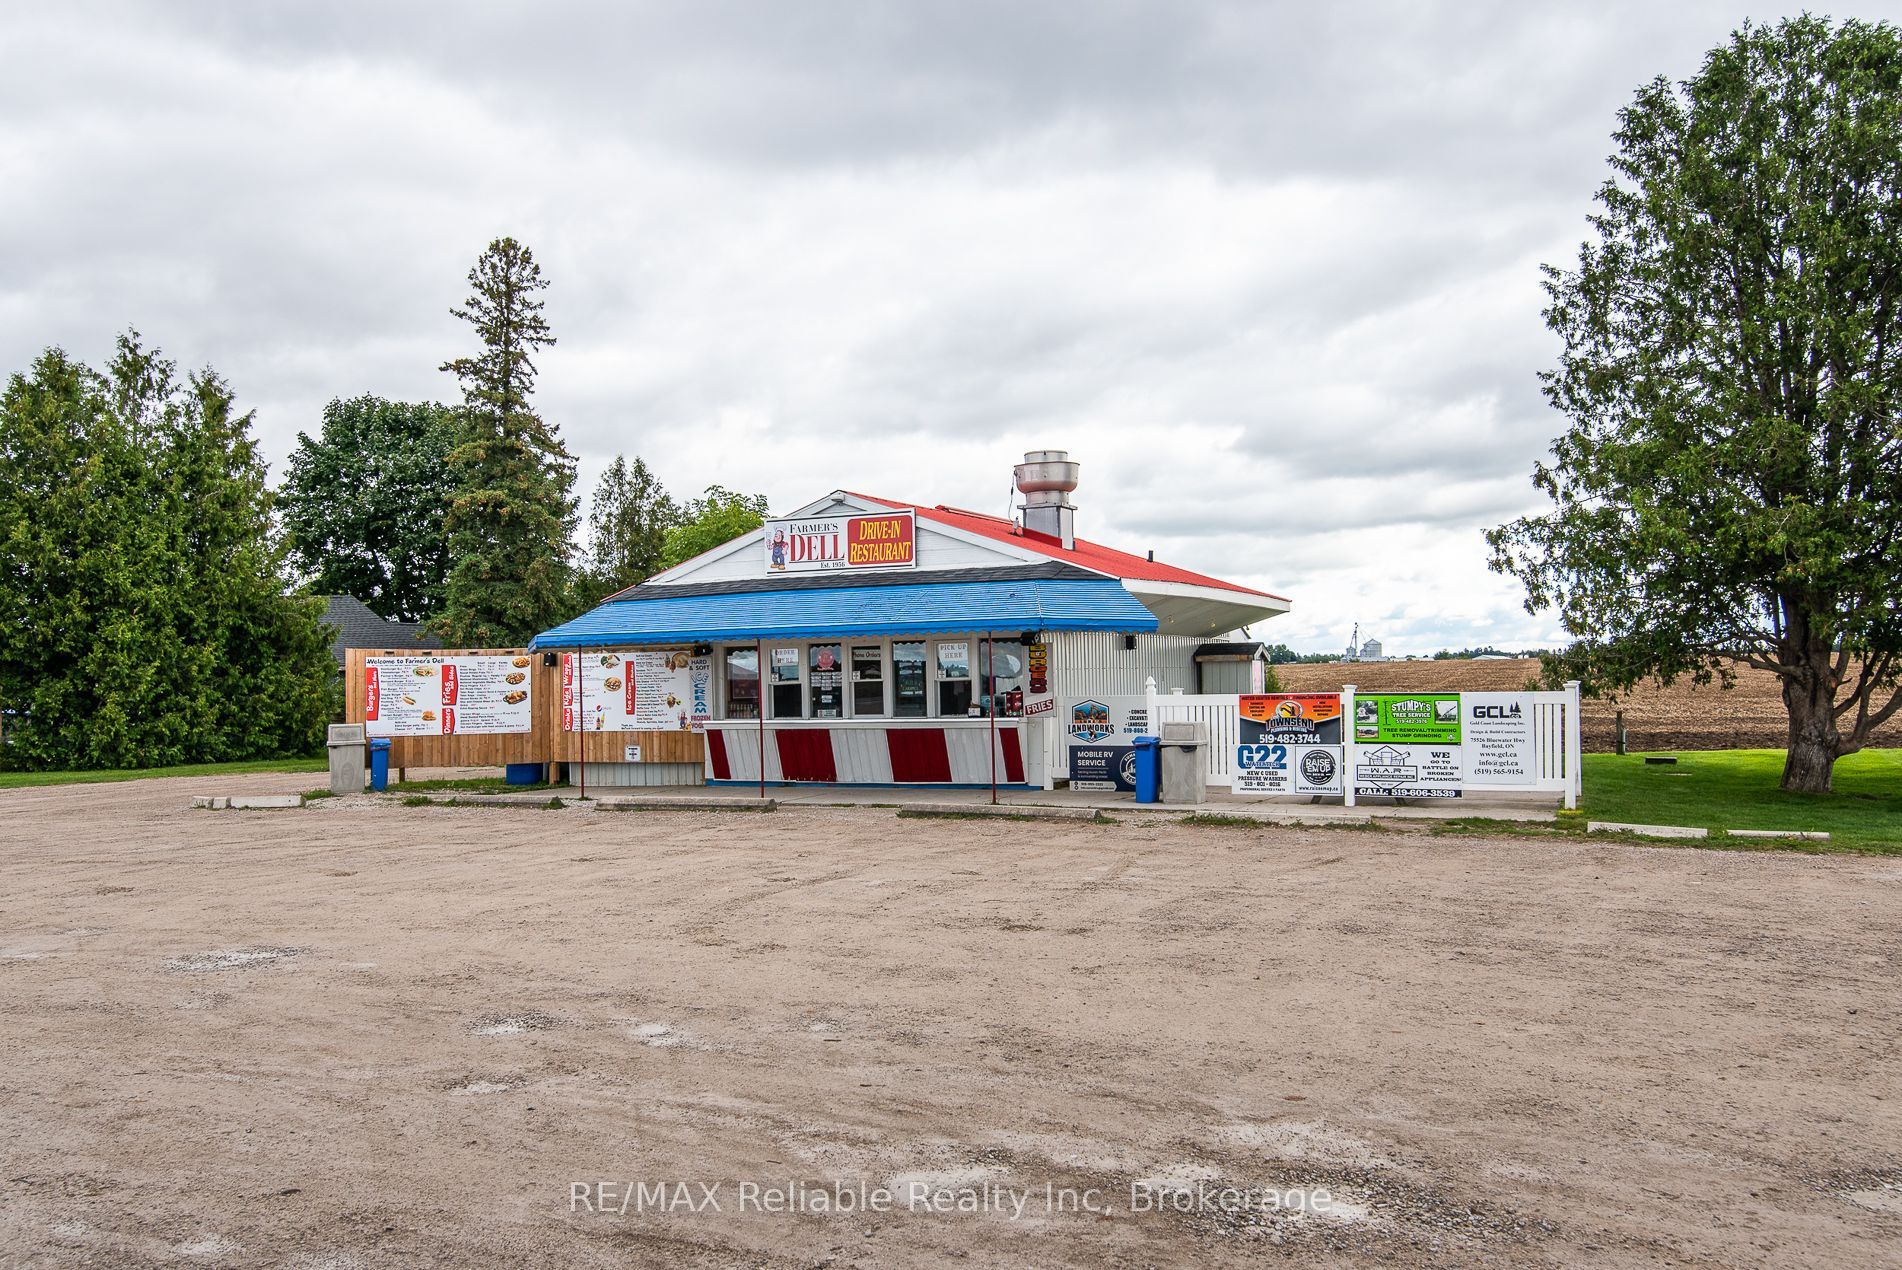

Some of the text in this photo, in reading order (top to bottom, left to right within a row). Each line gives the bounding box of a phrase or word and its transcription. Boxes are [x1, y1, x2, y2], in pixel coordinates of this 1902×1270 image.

[790, 523, 838, 533] FARMER'S
[859, 520, 901, 540] DRIVE-IN
[789, 534, 845, 561] DELL
[850, 542, 911, 562] RESTAURANT
[443, 682, 451, 704] Fries
[694, 683, 707, 713] CREAM
[1026, 700, 1052, 714] FRIES
[1391, 700, 1431, 711] STUMPY'S
[1473, 706, 1509, 718] GCL
[1068, 724, 1115, 734] LANDWORKS
[1265, 718, 1315, 731] TOWNSEND
[1238, 745, 1287, 769] G22
[1306, 759, 1330, 767] RAISE
[1320, 765, 1331, 773] UP
[1391, 789, 1455, 797] 519-606-3539
